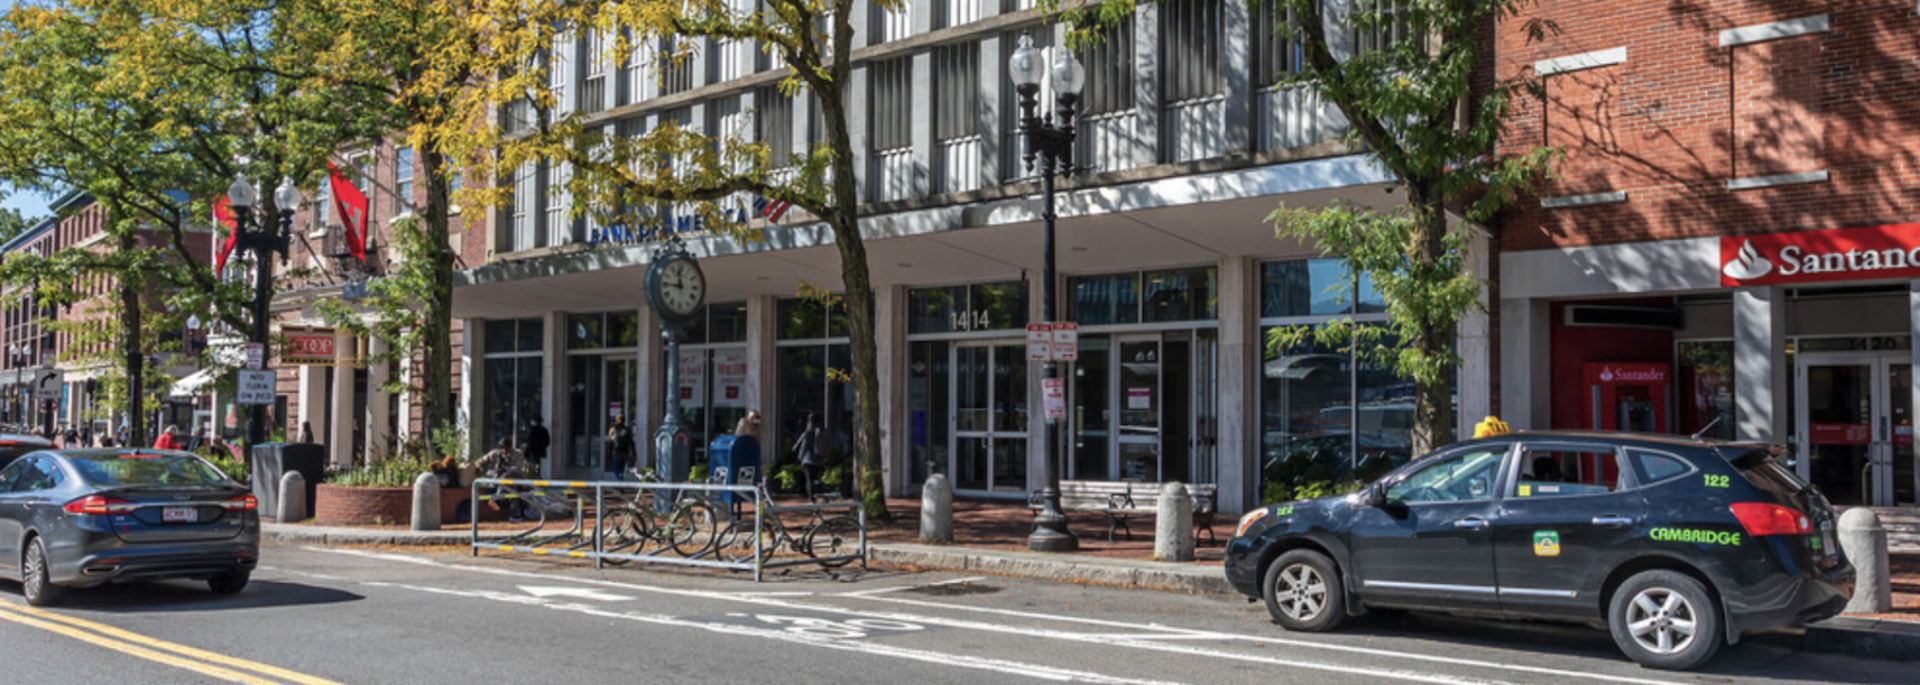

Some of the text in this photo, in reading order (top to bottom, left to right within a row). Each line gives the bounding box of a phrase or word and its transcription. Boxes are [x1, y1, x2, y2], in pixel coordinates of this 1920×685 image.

[664, 208, 746, 236] AMECA
[951, 309, 990, 330] 1414
[250, 373, 265, 381] NO
[1615, 367, 1664, 381] Santander
[240, 392, 272, 400] ON RED
[1704, 474, 1729, 488] 122
[1650, 527, 1740, 546] CAMBRIDGE
